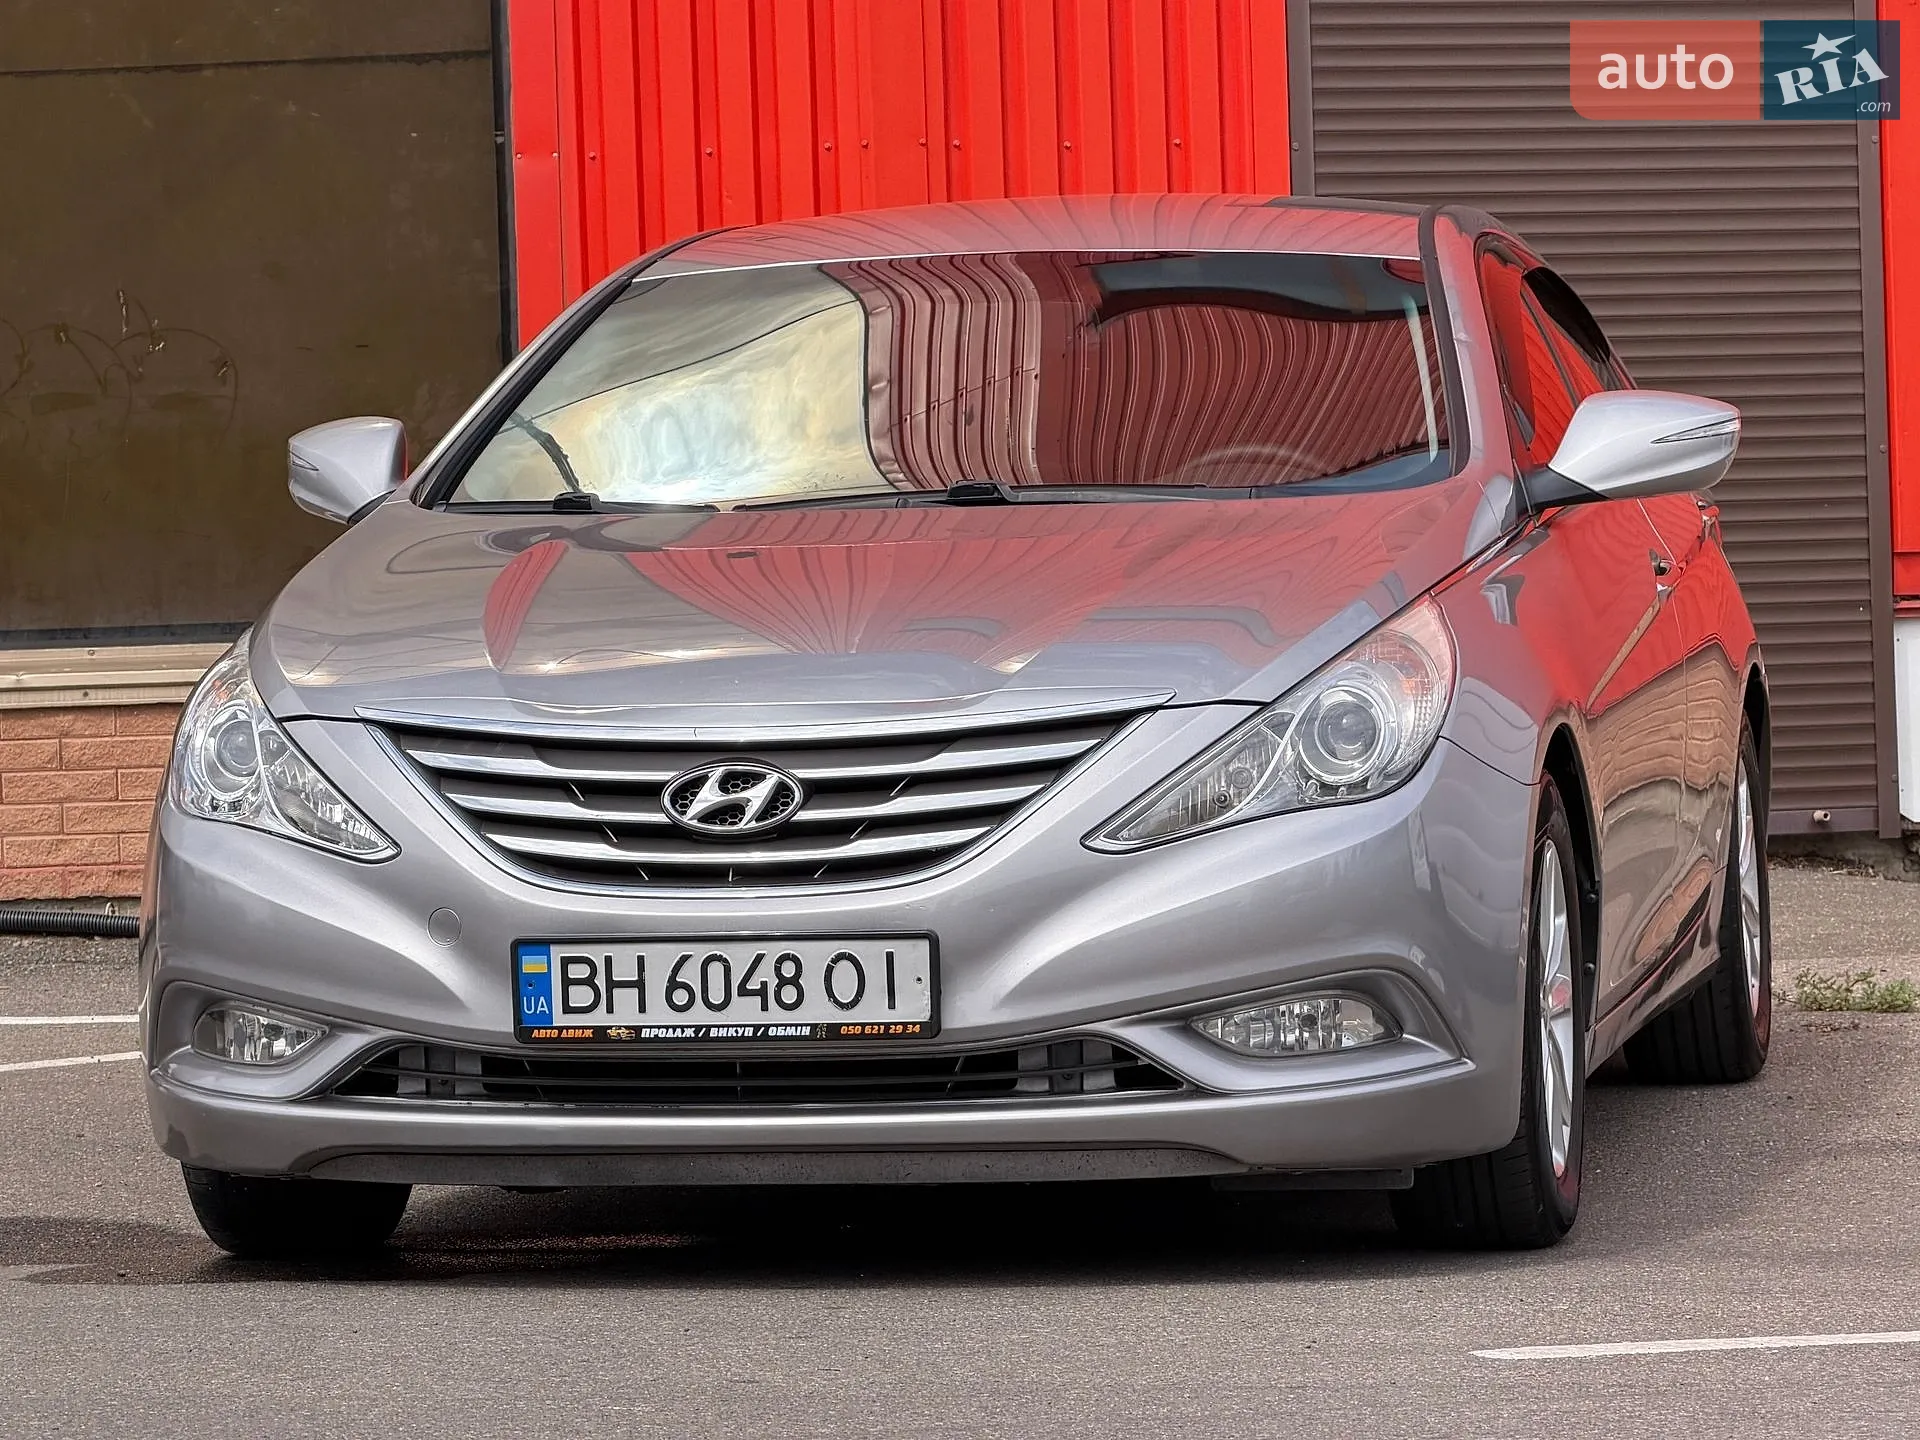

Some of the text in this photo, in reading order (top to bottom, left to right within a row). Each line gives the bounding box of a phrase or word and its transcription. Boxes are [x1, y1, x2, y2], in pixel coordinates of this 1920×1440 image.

[559, 950, 896, 1015] BH 6048 OI
[522, 997, 549, 1015] UA
[531, 1029, 559, 1038] АВТО
[561, 1028, 594, 1038] ДВИЖ
[641, 1028, 695, 1038] ПРОДАЖ
[709, 1027, 754, 1037] ВИКУП
[768, 1026, 811, 1036] ОБМІН
[840, 1025, 863, 1035] 050
[864, 1025, 885, 1034] 621
[888, 1024, 904, 1034] 29
[906, 1024, 921, 1033] 34
